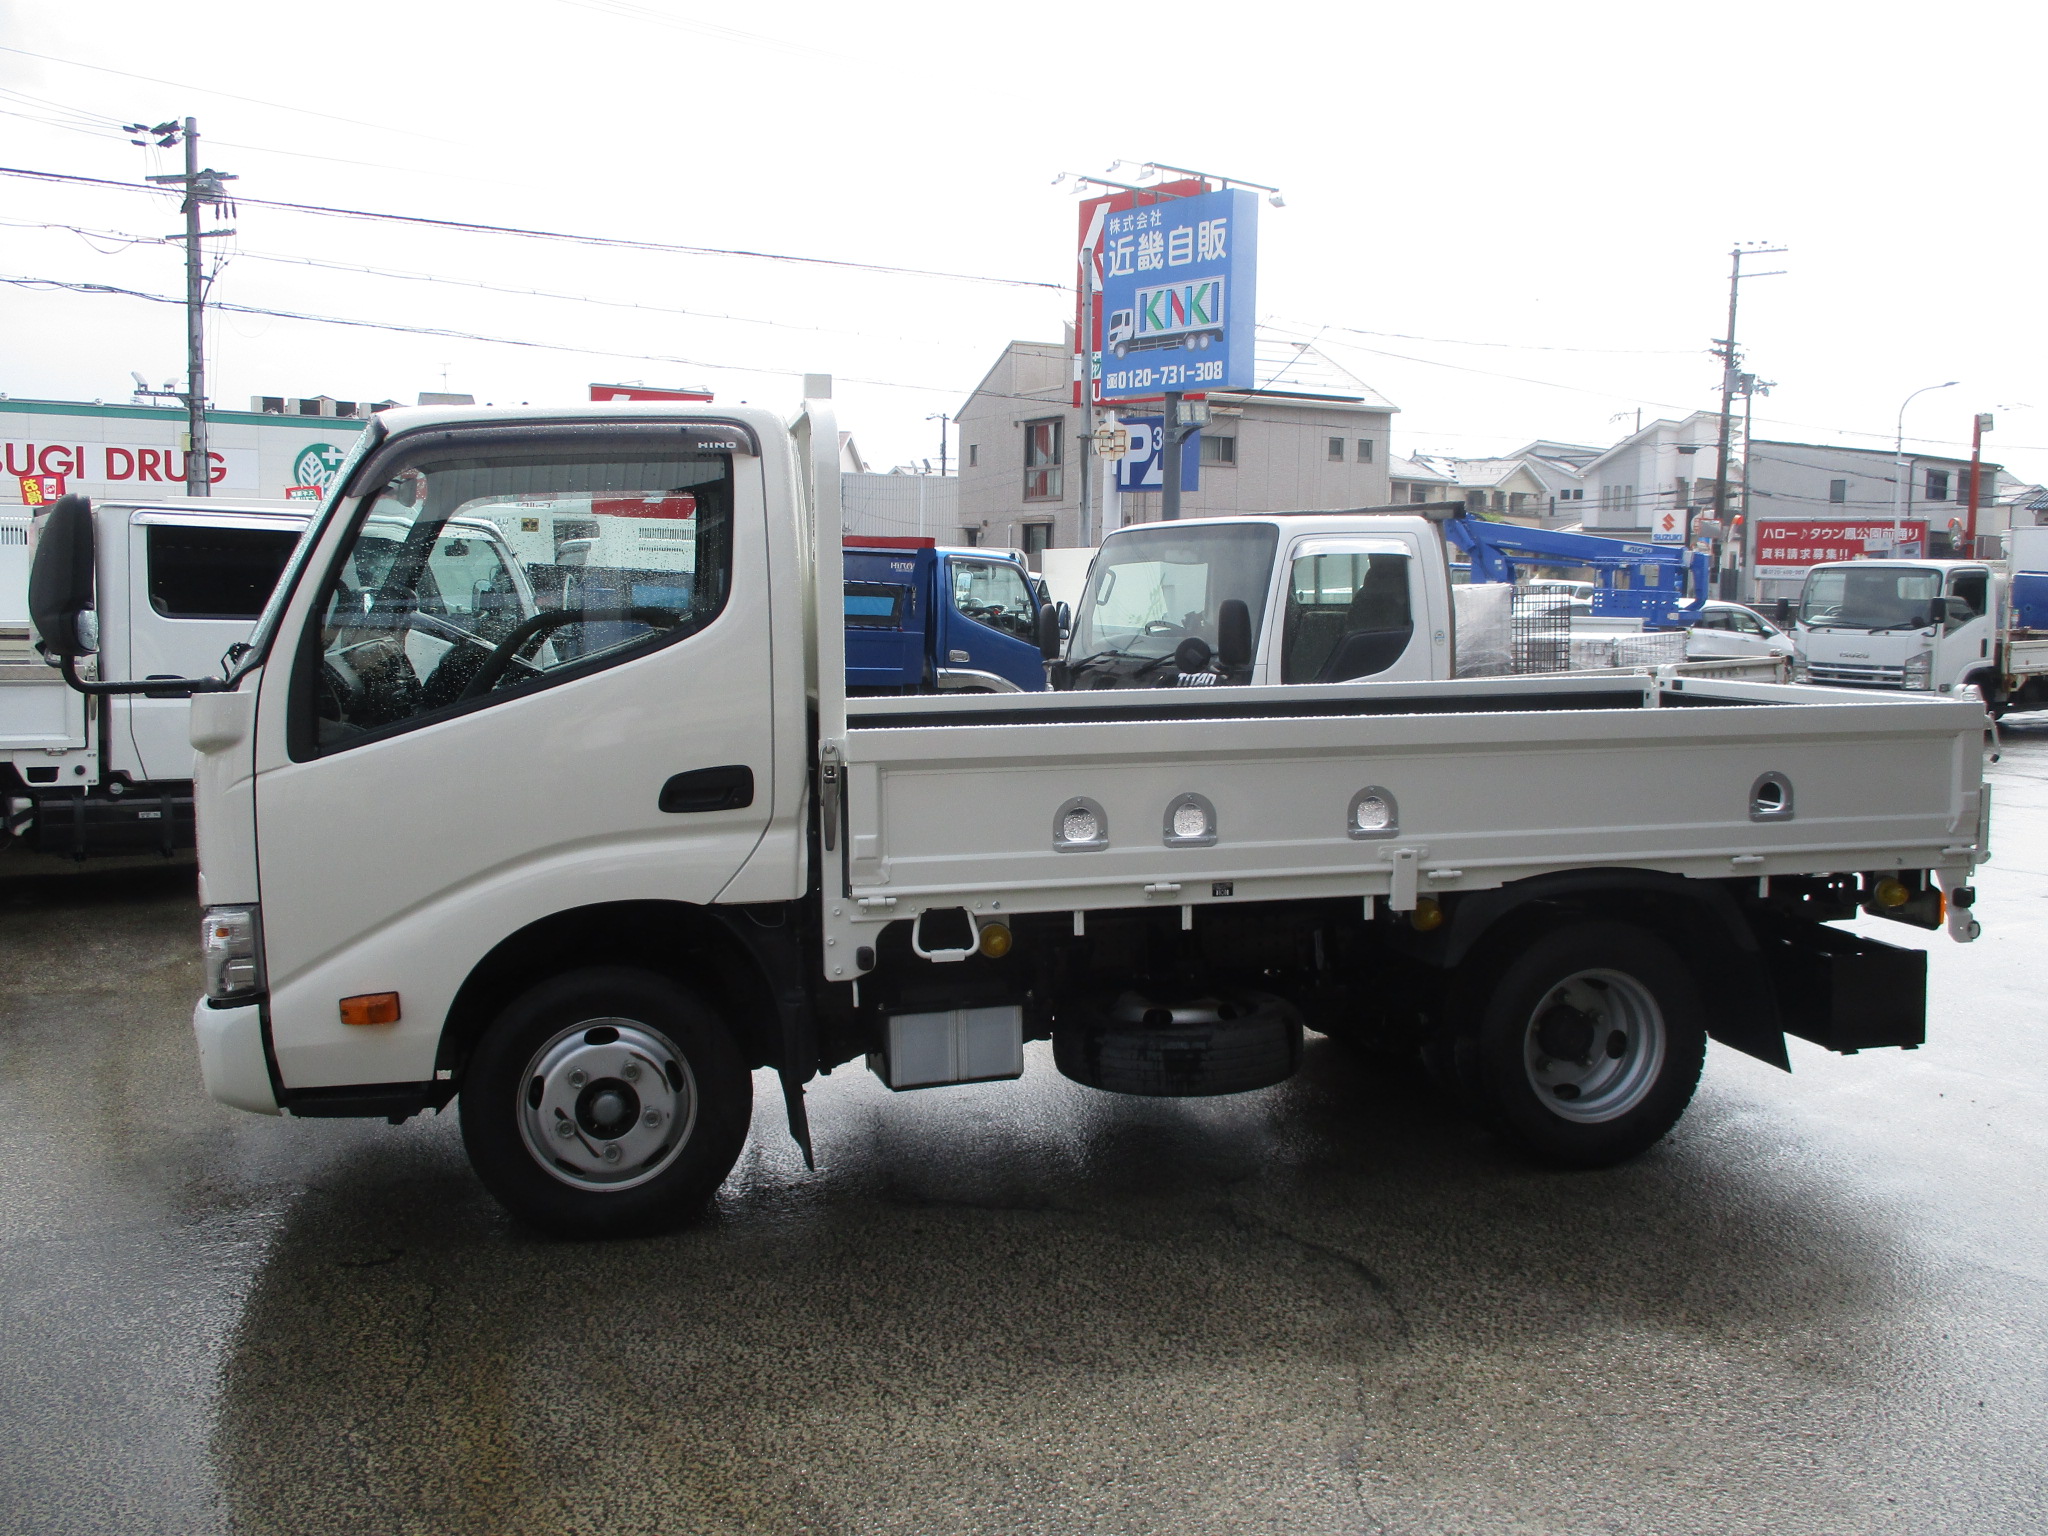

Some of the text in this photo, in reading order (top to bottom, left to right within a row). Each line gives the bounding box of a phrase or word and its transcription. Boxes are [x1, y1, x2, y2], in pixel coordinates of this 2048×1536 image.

[1109, 209, 1161, 235] 株式会社
[1108, 218, 1227, 278] 近畿自販
[1139, 281, 1219, 333] KNKI
[1118, 361, 1223, 389] 0120-731-308
[698, 441, 736, 449] HINO
[1120, 424, 1152, 485] P
[0, 443, 84, 479] UGI
[1653, 533, 1683, 541] SUZUKI
[1177, 672, 1217, 686] TITAN
